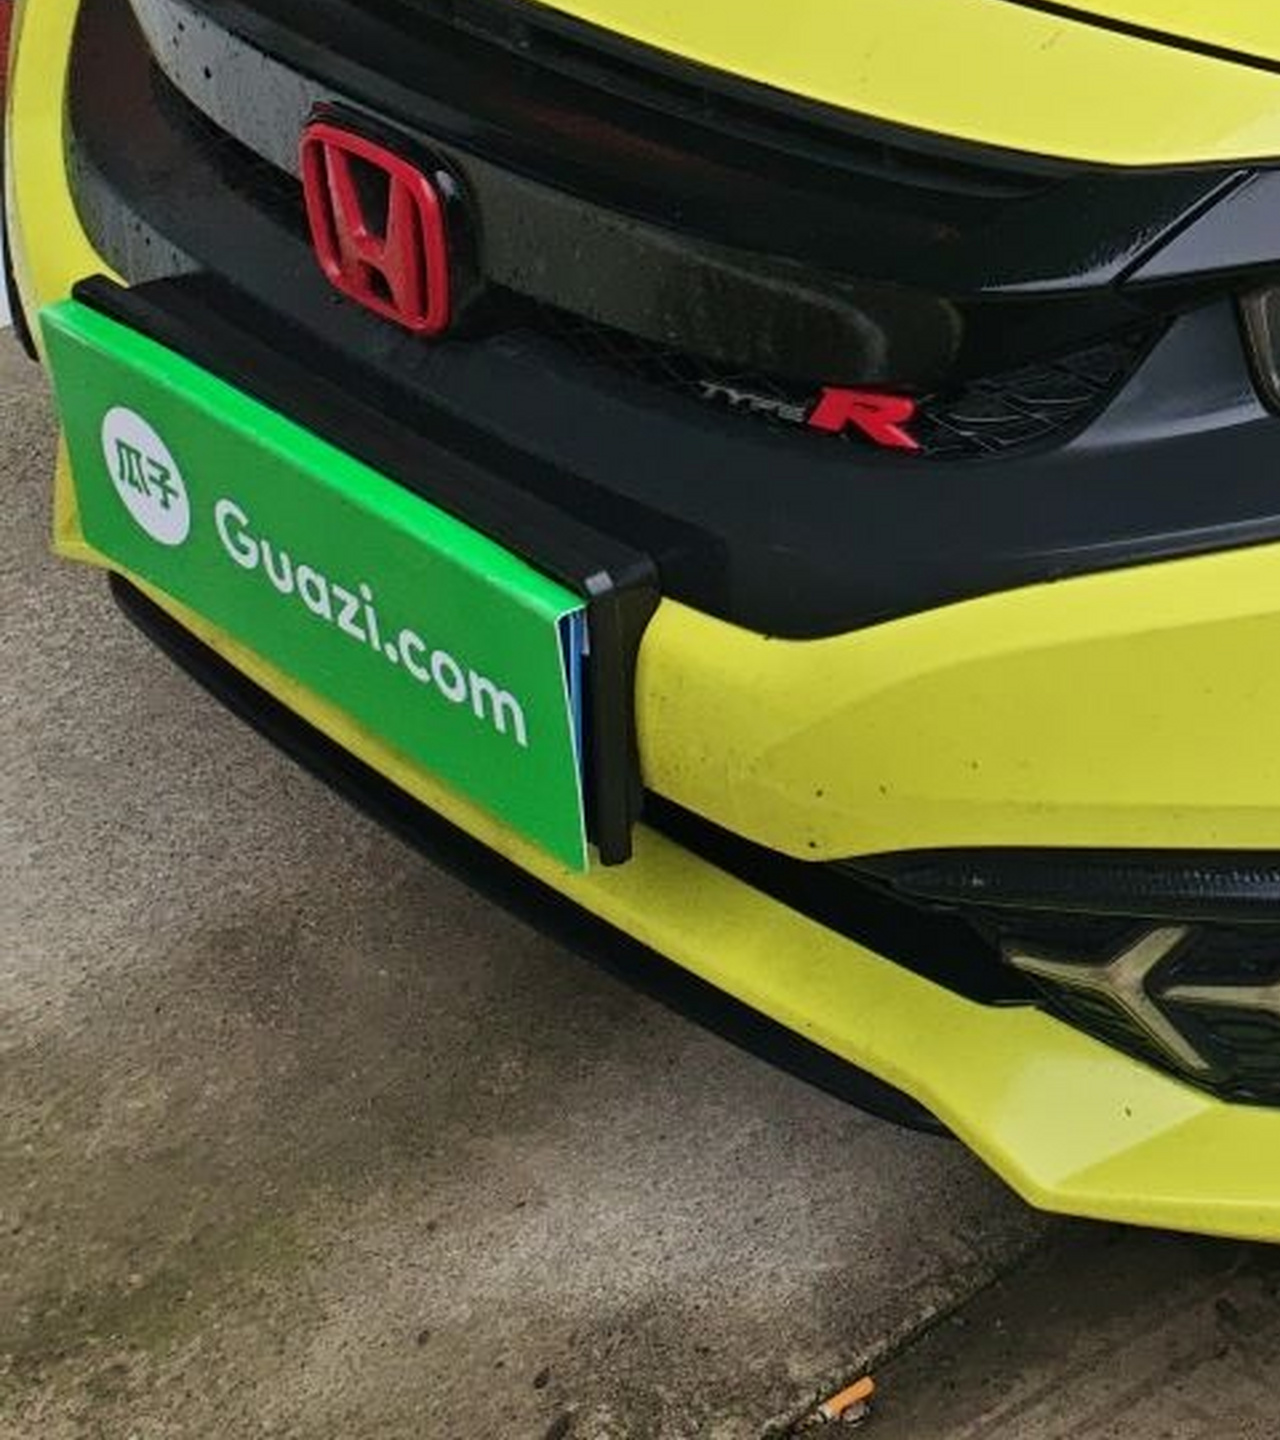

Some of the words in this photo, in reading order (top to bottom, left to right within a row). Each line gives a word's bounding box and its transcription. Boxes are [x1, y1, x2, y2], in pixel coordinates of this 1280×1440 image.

[807, 386, 920, 451] R
[114, 438, 180, 510] 瓜子
[214, 498, 528, 747] Guazi.com
